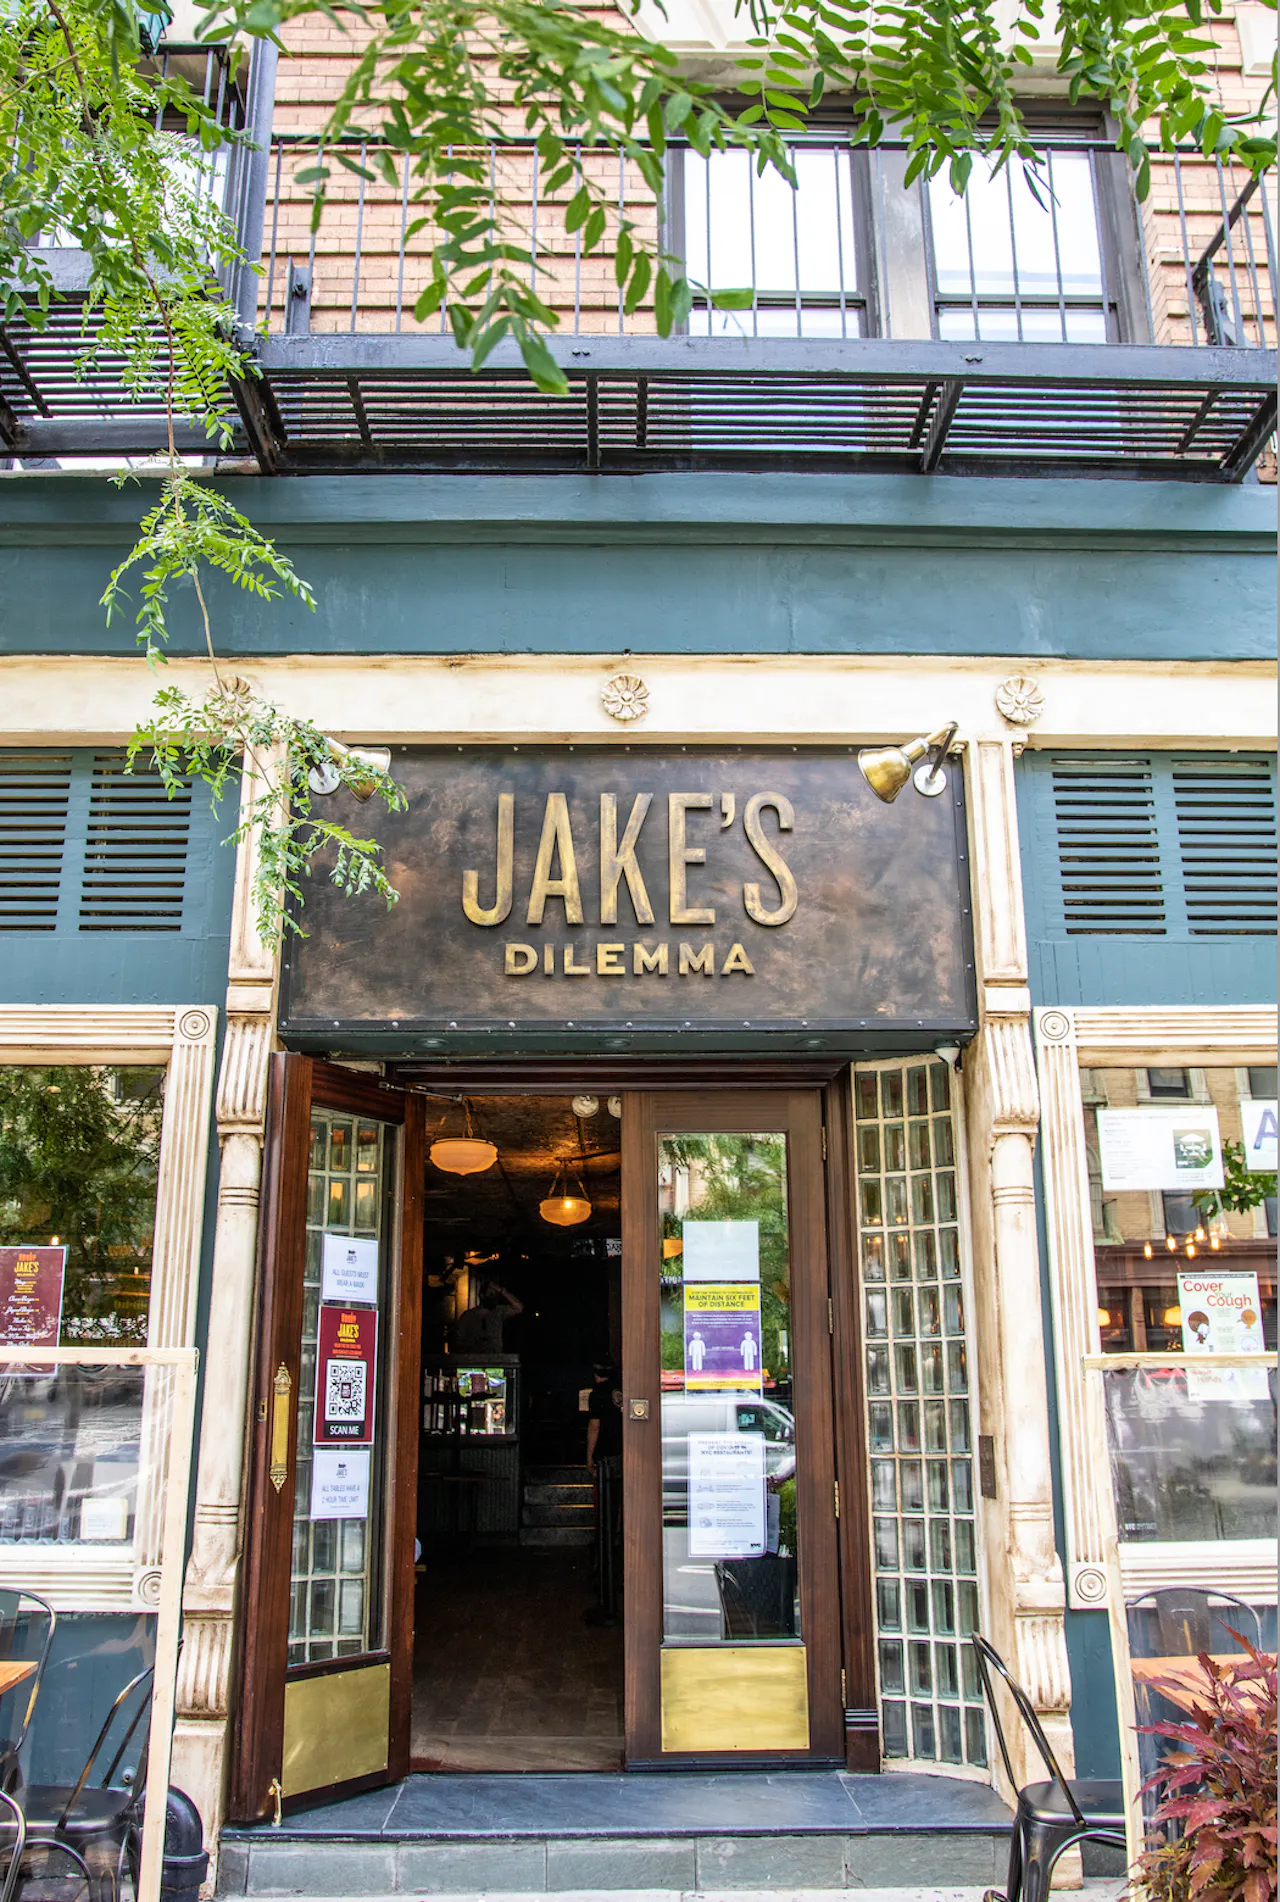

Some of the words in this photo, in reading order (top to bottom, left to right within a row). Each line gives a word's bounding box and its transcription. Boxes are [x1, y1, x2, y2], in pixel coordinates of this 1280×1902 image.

[462, 791, 799, 927] JAKE'S
[504, 943, 756, 975] DILEMMA
[1183, 1280, 1224, 1292] Cover
[1206, 1294, 1252, 1310] Cough
[330, 1424, 348, 1435] SCAN
[348, 1424, 360, 1435] ME
